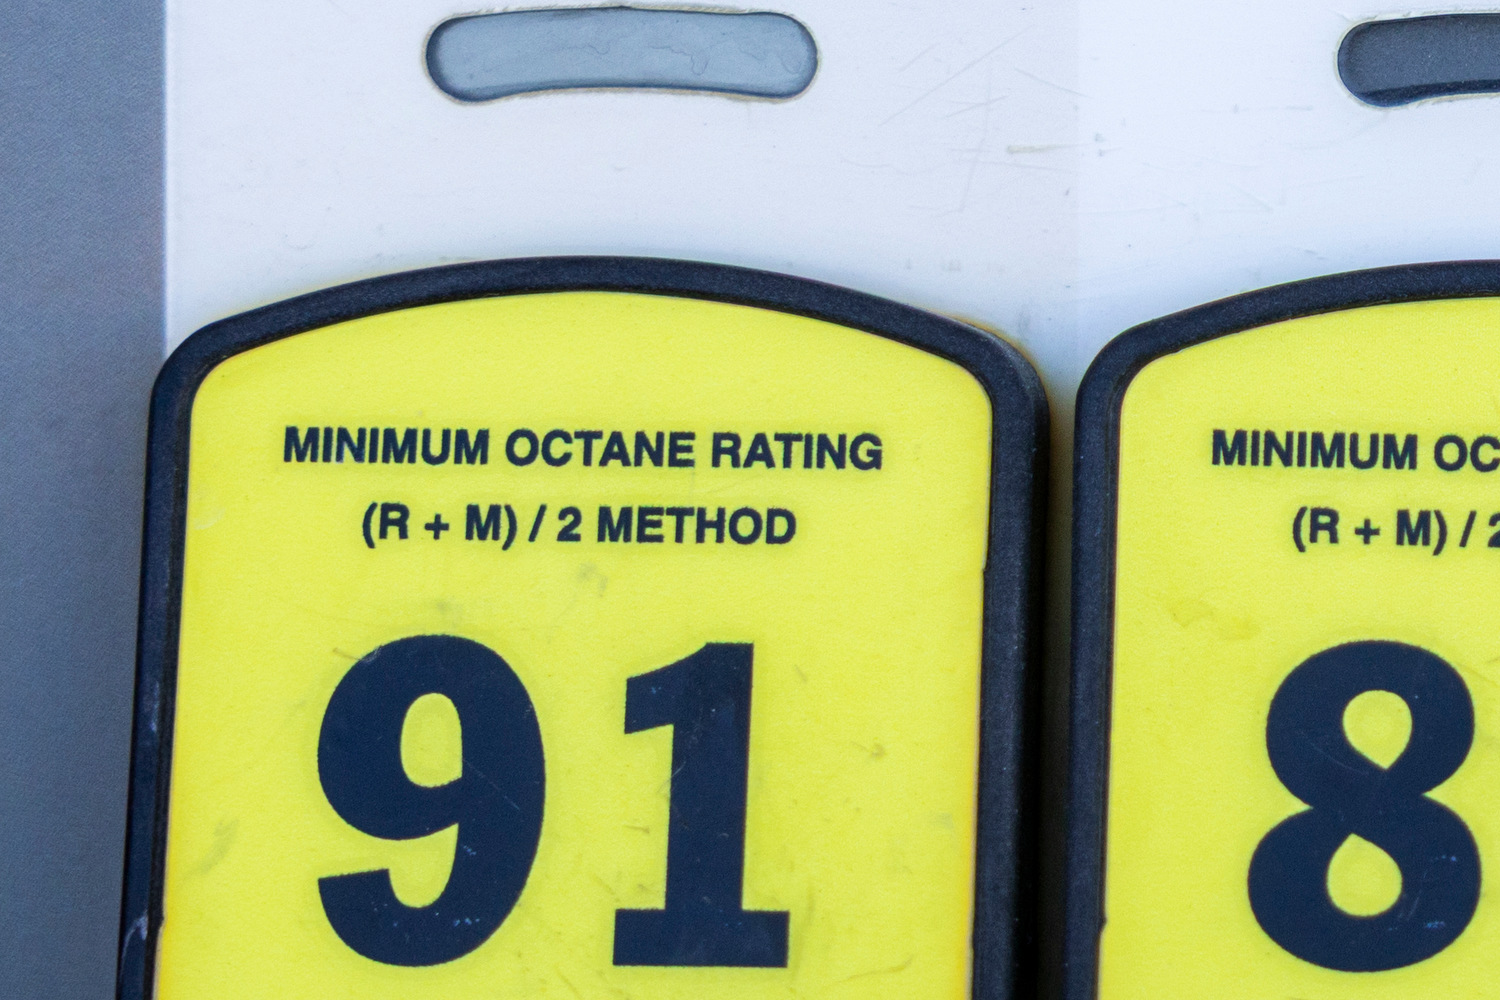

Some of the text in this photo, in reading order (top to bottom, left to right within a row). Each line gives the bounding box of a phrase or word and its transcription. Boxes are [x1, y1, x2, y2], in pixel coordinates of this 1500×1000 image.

[282, 426, 883, 471] MINIMUM OCTANE RATING
[1211, 429, 1418, 472] MINIMUM
[362, 502, 796, 549] (R + M) / 2 METHOD
[1291, 506, 1339, 553] (R
[1354, 518, 1380, 545] +
[1395, 509, 1448, 556] M)
[1459, 511, 1477, 548] /
[316, 634, 791, 968] 91
